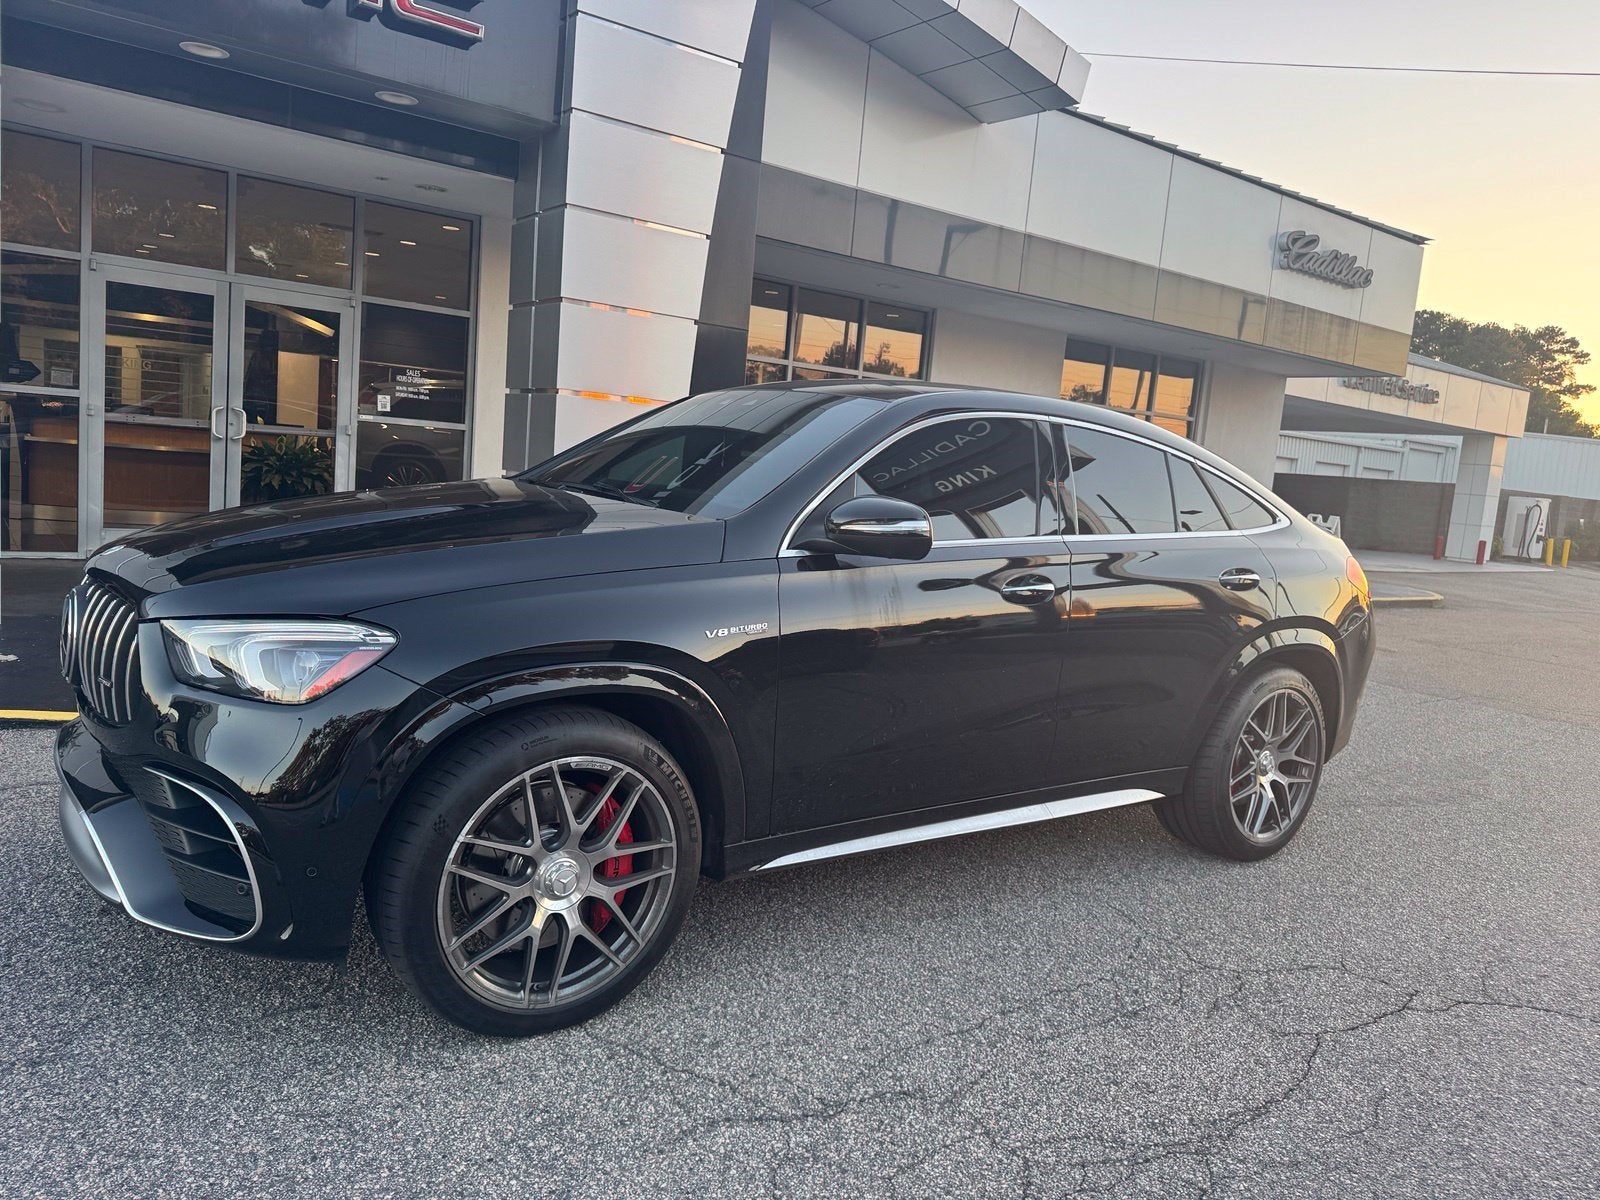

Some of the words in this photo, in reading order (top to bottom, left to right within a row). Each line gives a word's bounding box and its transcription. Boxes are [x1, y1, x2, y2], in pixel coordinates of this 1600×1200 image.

[1280, 230, 1374, 289] Cadillac
[406, 369, 420, 377] SALES
[1401, 379, 1440, 404] Service
[705, 628, 729, 639] V8
[730, 622, 769, 634] BITURBO
